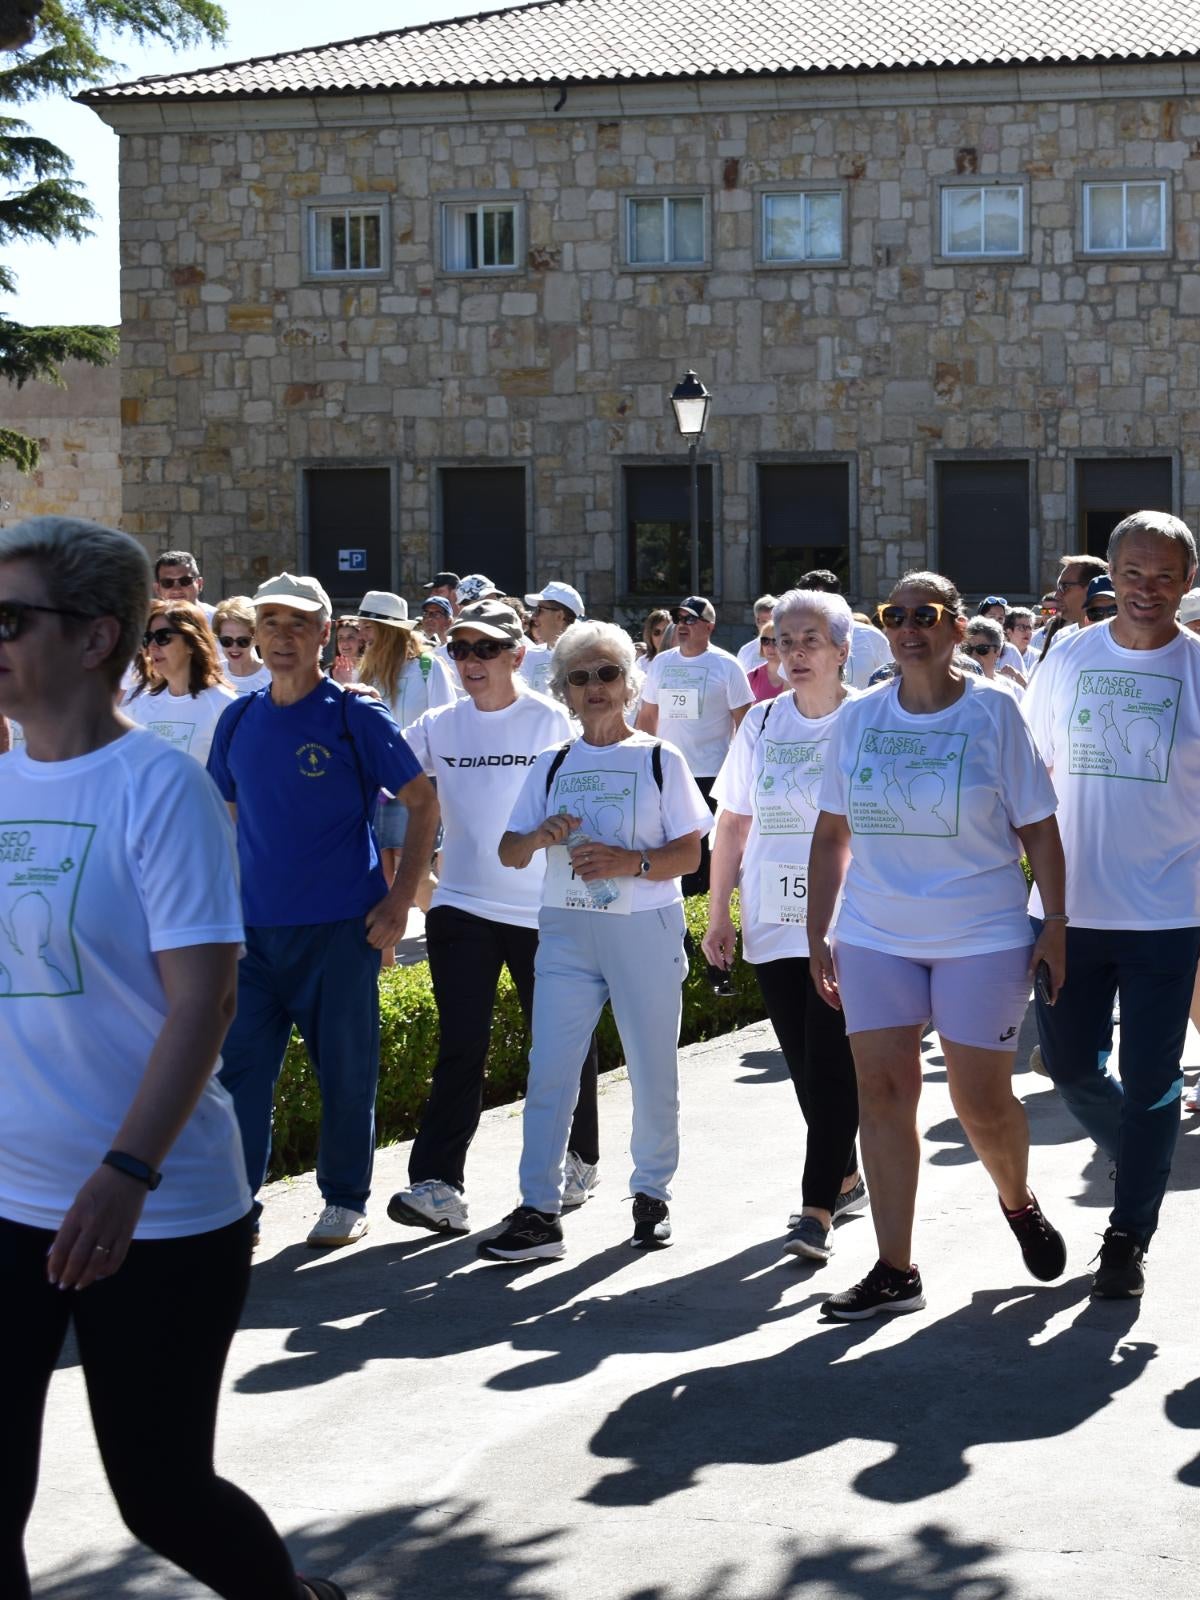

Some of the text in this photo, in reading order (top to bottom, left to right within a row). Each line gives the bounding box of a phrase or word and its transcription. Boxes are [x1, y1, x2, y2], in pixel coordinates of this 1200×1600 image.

[353, 554, 362, 566] P
[1083, 675, 1136, 688] IX PASEO
[1081, 685, 1143, 698] SALUDABLE
[671, 695, 687, 706] 79
[866, 734, 879, 746] IX
[767, 745, 777, 757] IX
[863, 744, 927, 756] SALUDABLE
[458, 754, 538, 768] DIADORA
[766, 753, 822, 764] SALUDABLE
[571, 775, 600, 785] PASEO
[561, 783, 607, 794] SALUDABLE
[779, 876, 807, 898] 15
